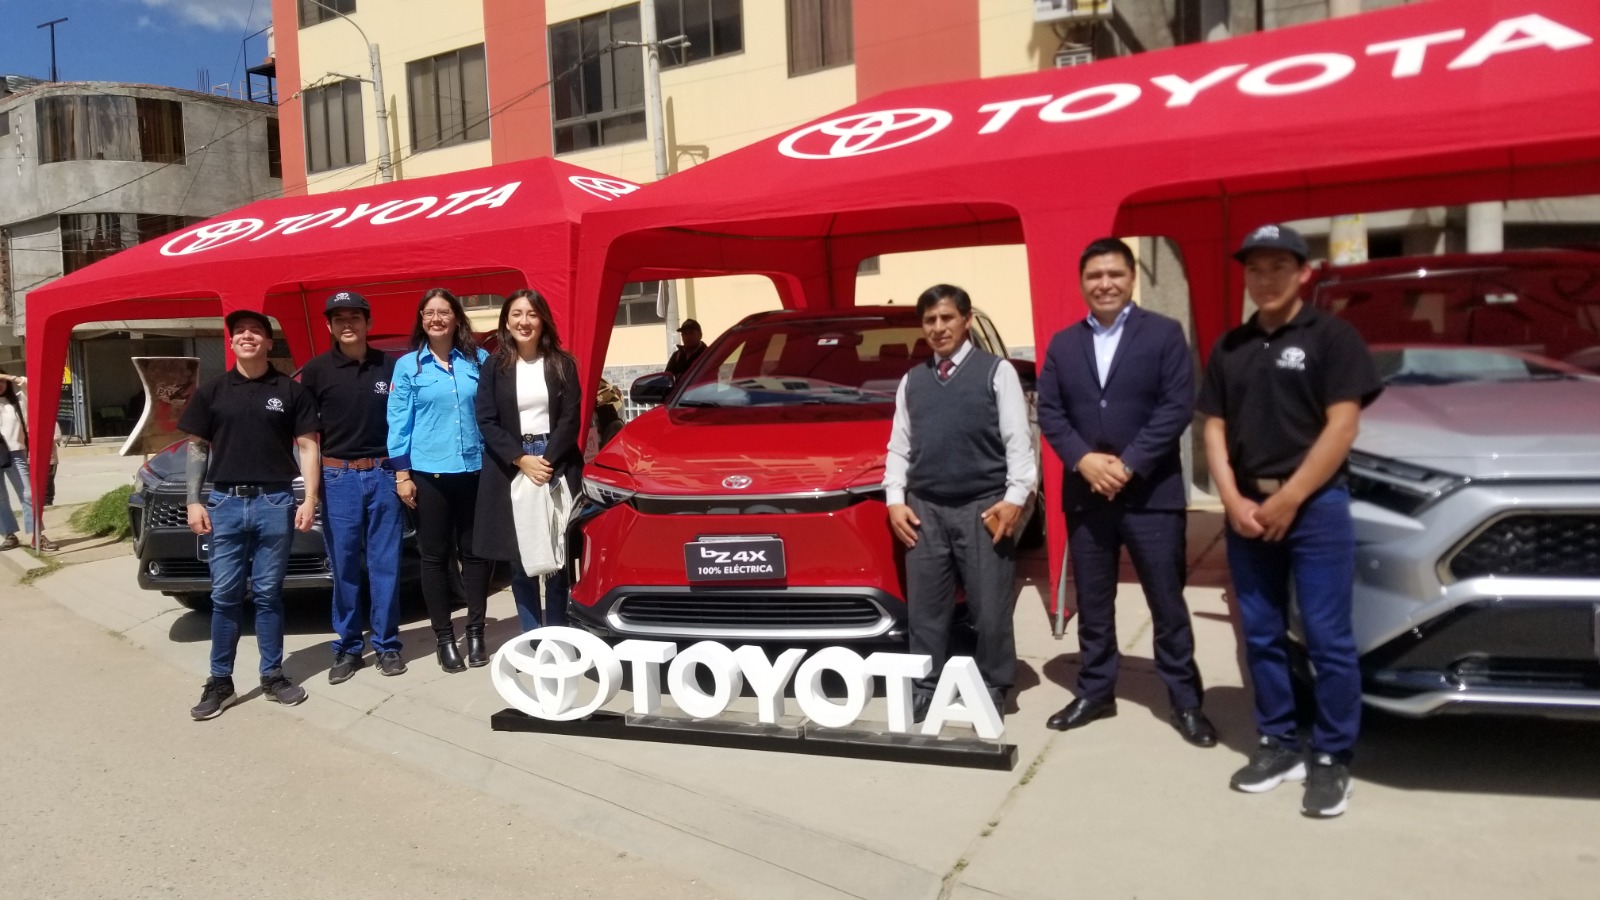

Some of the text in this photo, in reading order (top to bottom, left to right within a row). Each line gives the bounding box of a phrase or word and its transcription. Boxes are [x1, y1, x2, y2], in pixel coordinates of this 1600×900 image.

[977, 15, 1593, 136] TOYOTA
[249, 181, 521, 241] TOYOTA
[697, 564, 773, 575] 100% ELÉCTRICA
[615, 639, 1004, 739] TOYOTA
